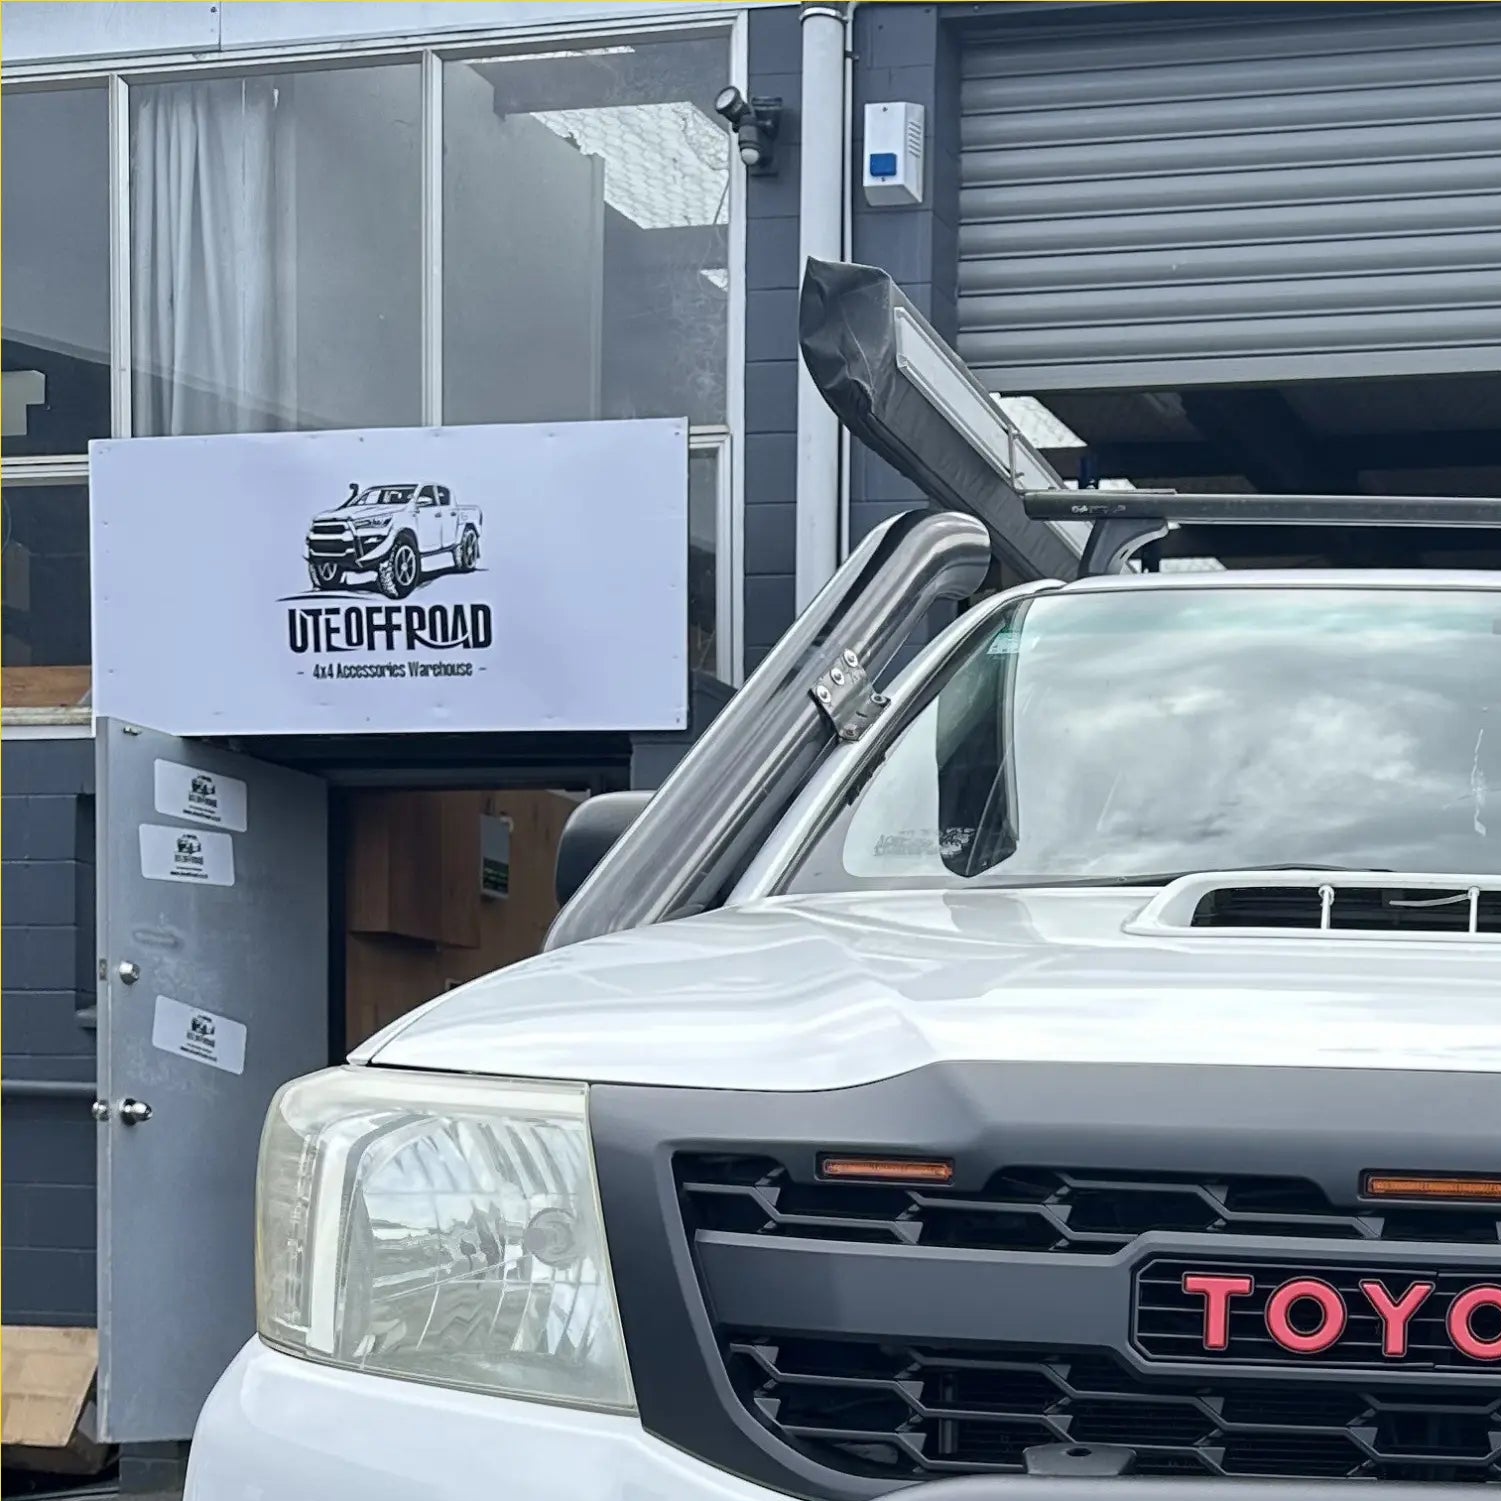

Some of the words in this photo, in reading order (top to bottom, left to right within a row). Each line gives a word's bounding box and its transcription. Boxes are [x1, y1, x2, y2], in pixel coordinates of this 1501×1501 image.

[288, 604, 492, 653] UTEOFFROAD
[313, 664, 334, 679] 4x4
[336, 661, 406, 679] Accessories
[407, 661, 473, 678] Warehouse
